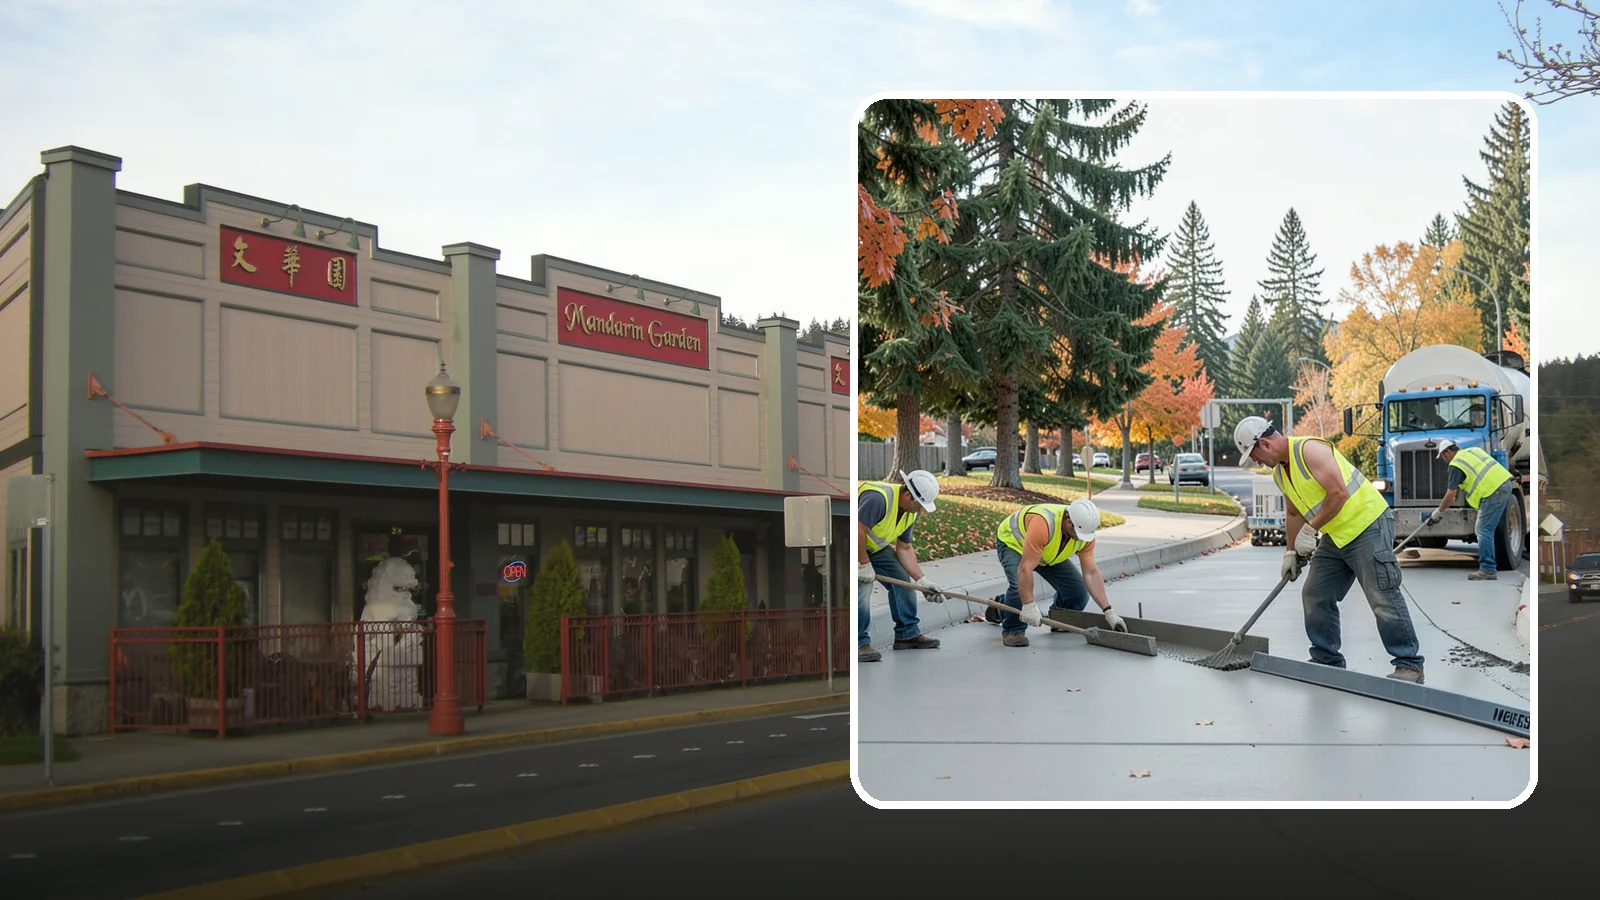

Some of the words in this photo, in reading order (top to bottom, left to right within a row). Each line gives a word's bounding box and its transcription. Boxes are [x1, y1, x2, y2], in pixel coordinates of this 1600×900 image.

[230, 235, 346, 291] 文華園
[564, 302, 644, 341] Mandarin
[648, 320, 702, 352] Garden
[835, 363, 846, 386] 文
[503, 565, 527, 578] OPEN
